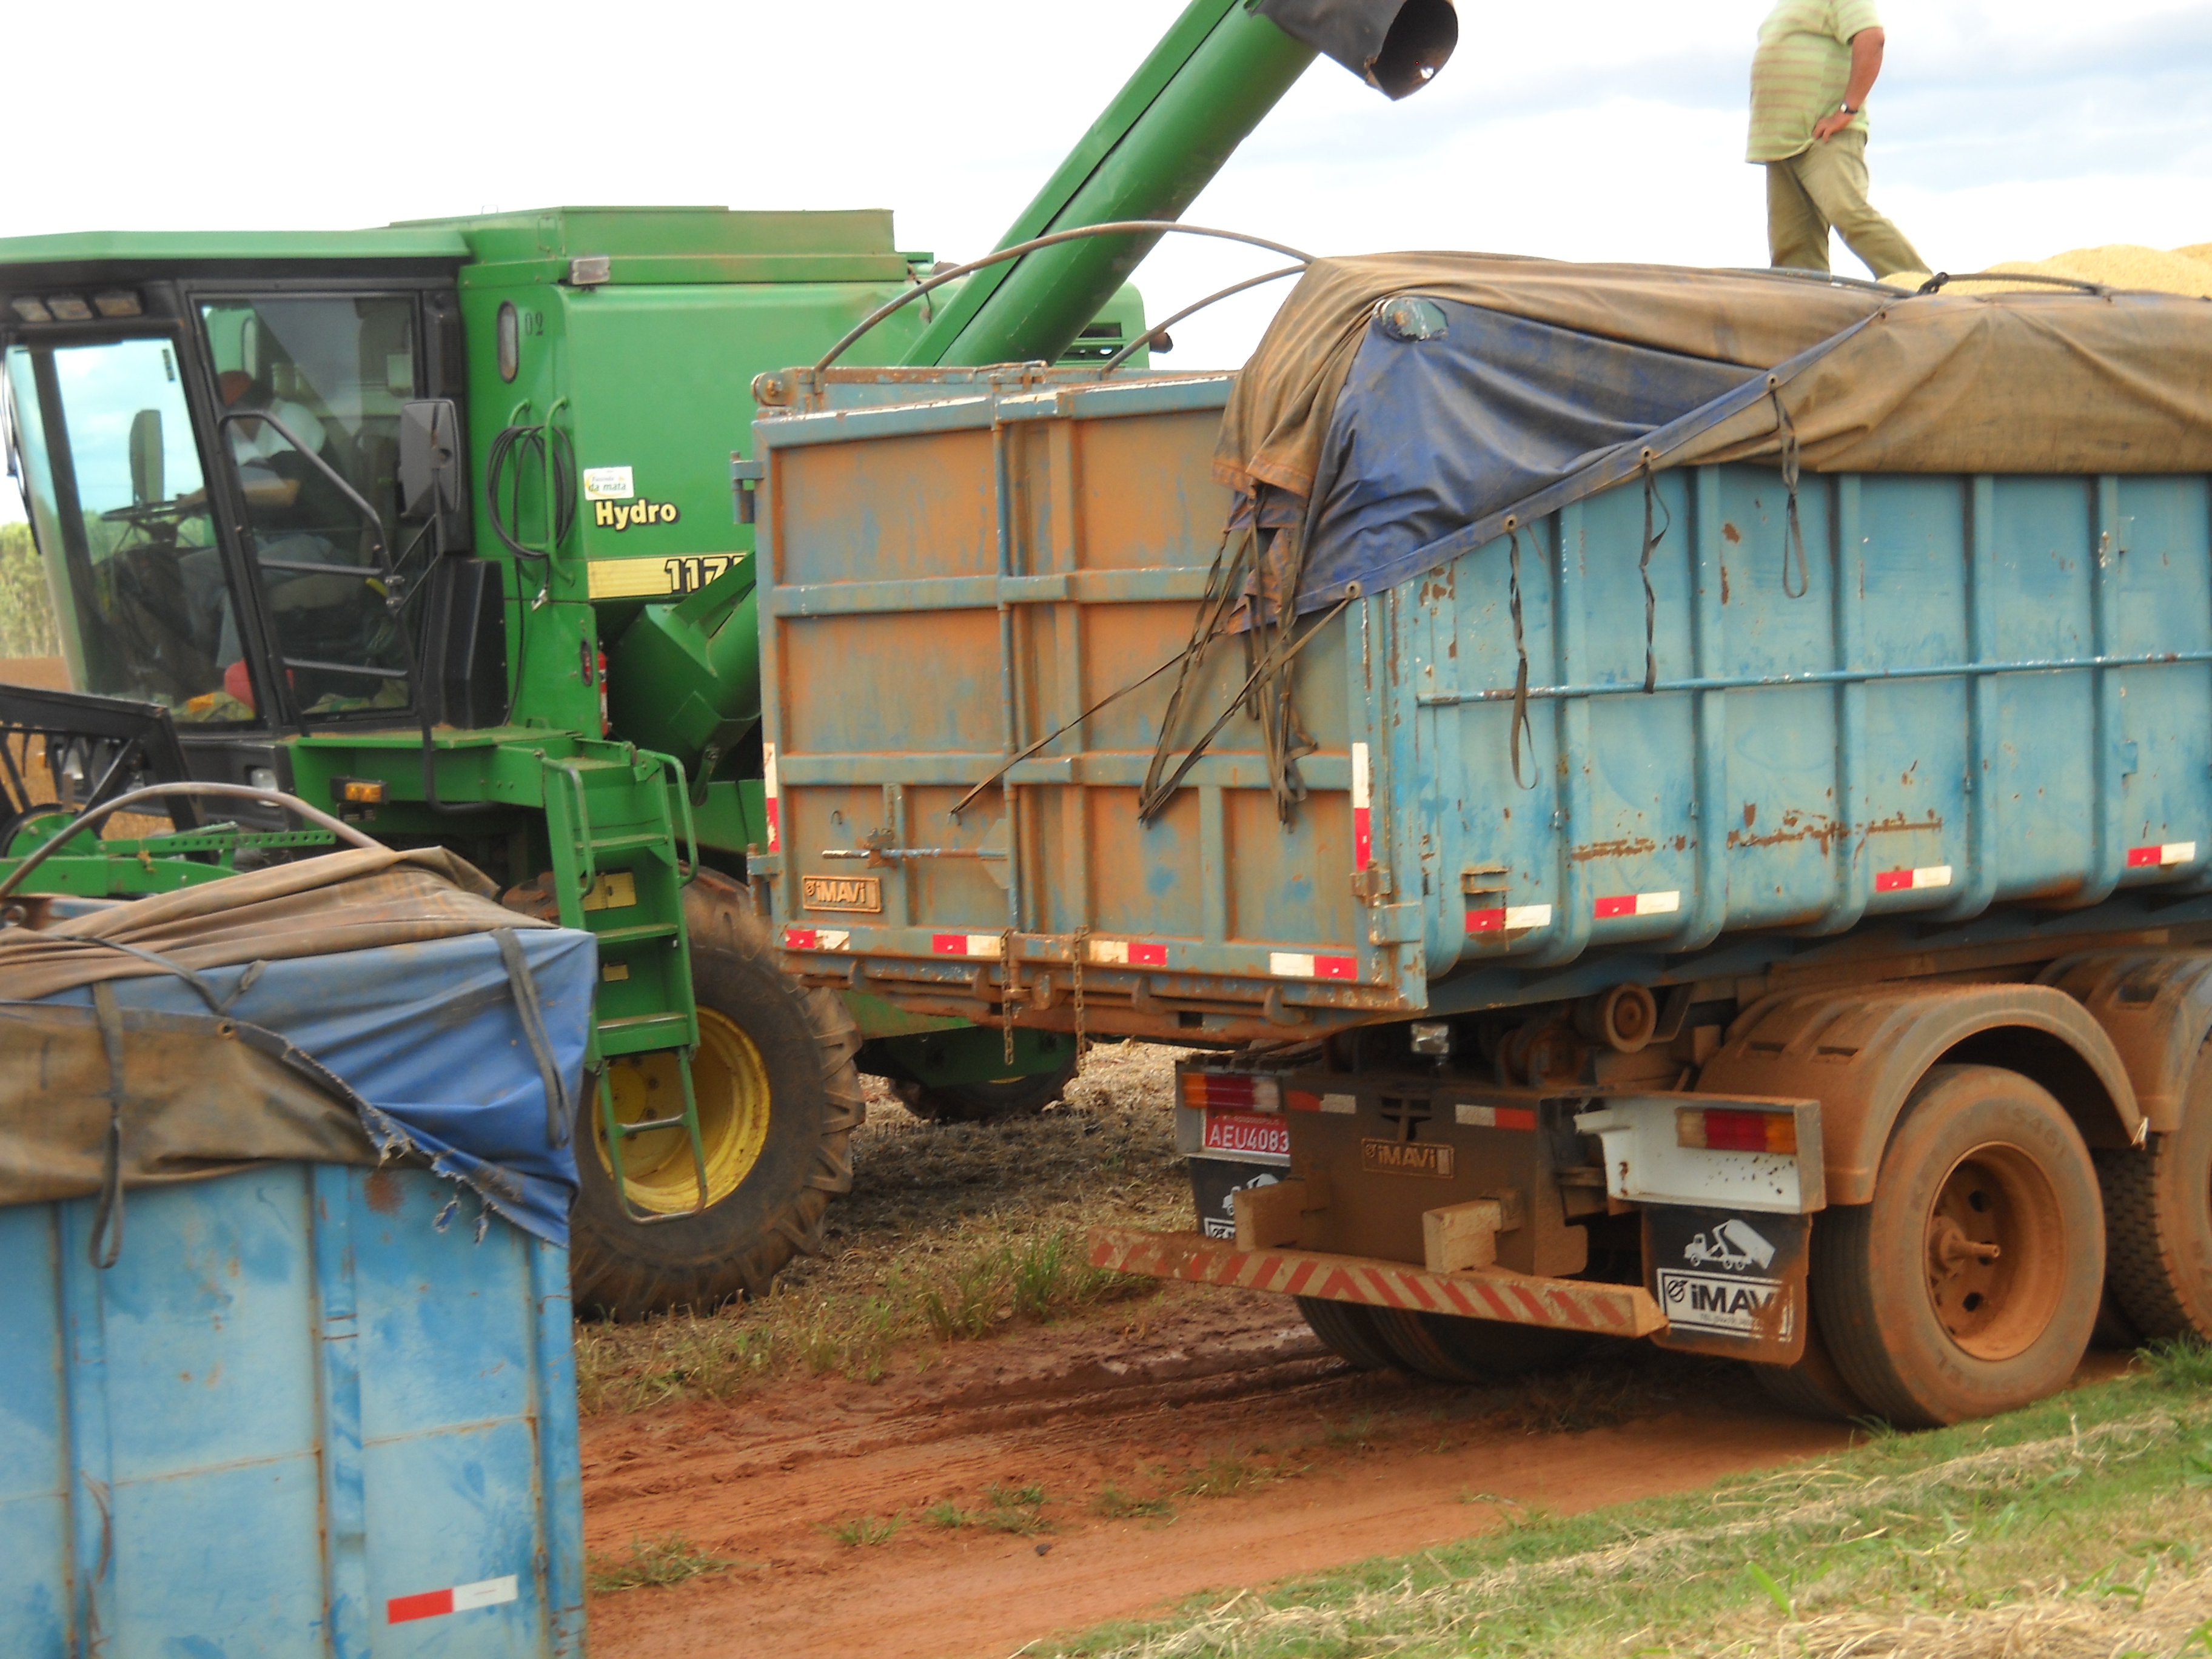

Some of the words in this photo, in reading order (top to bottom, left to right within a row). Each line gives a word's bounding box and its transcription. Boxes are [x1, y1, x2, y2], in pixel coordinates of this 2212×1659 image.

[588, 483, 600, 492] da
[595, 498, 679, 531] Hydro
[665, 555, 745, 594] 117
[1208, 1124, 1290, 1151] AEU4083
